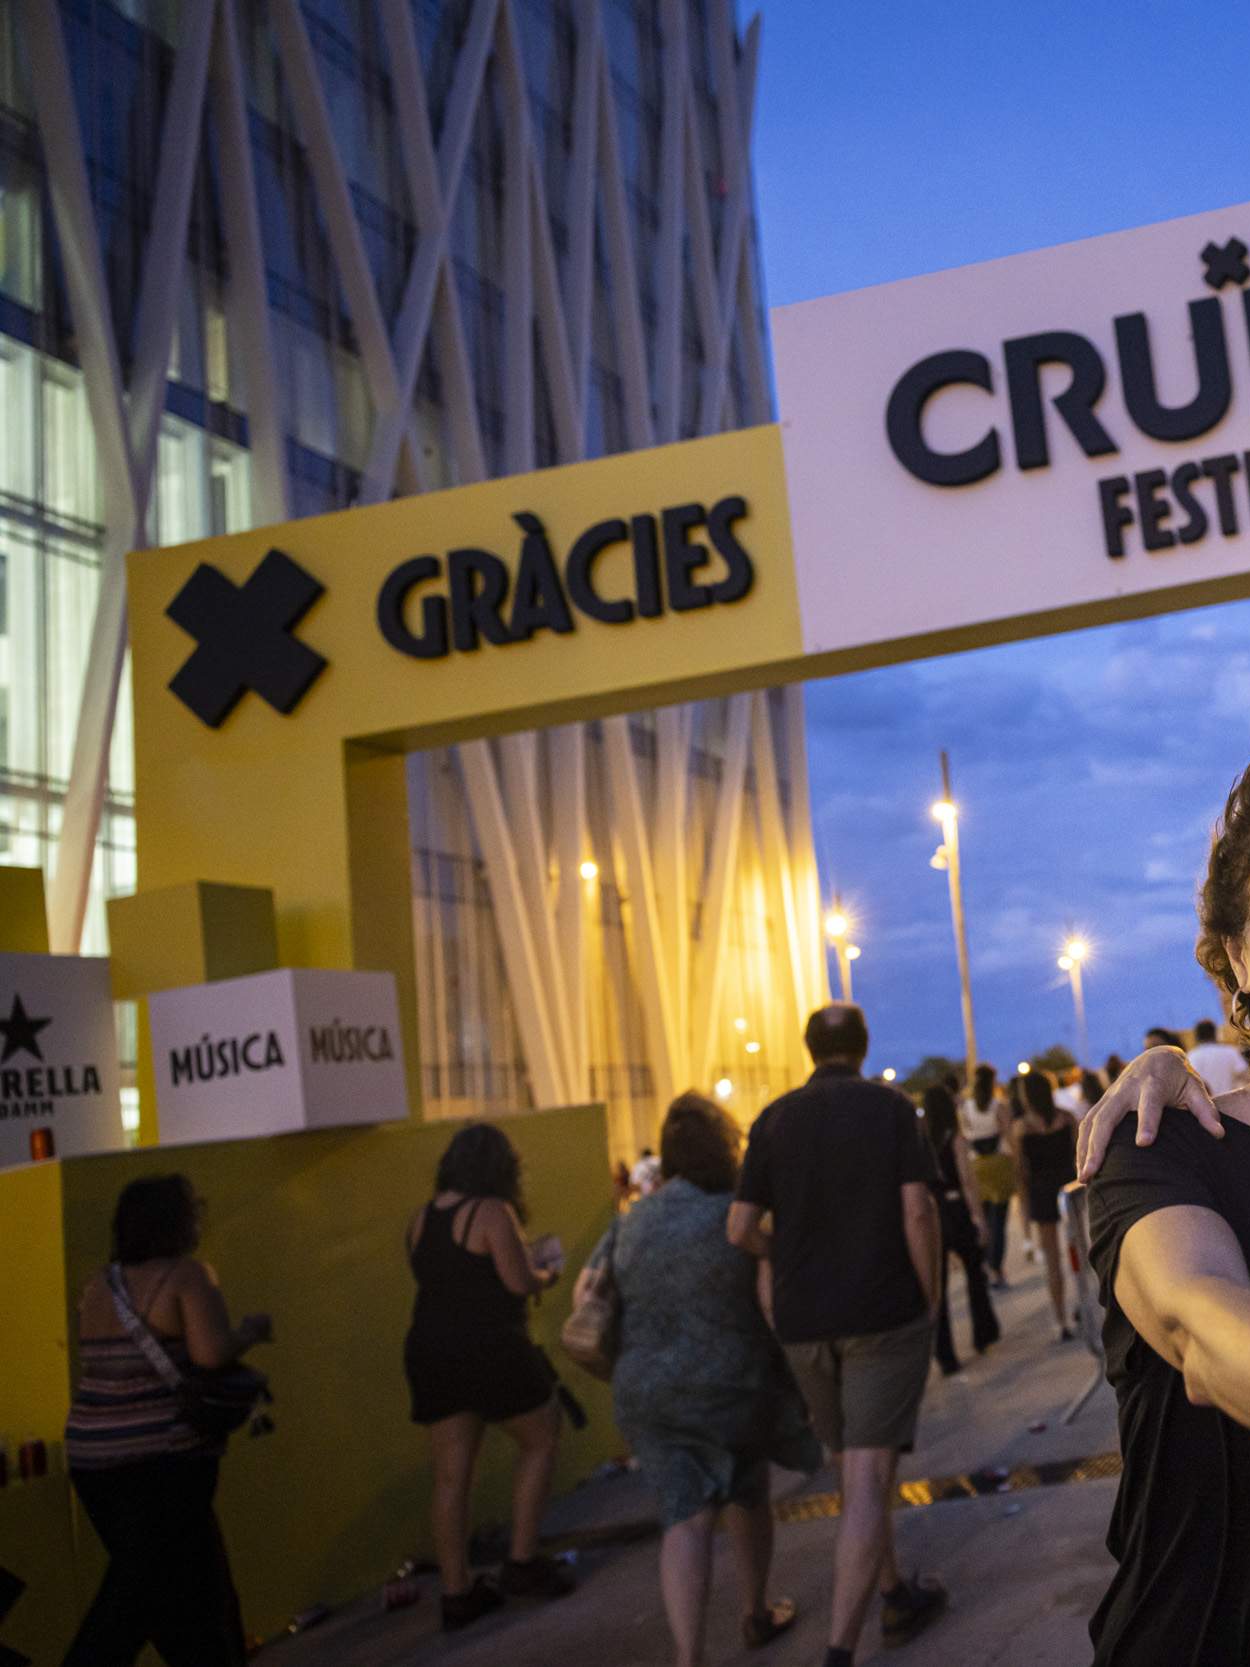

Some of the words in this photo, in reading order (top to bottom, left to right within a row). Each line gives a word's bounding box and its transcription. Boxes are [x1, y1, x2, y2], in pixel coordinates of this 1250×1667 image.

[377, 495, 755, 659] GRÀCIES
[168, 1030, 285, 1088] MÚSICA
[309, 1017, 395, 1064] MÚSICA
